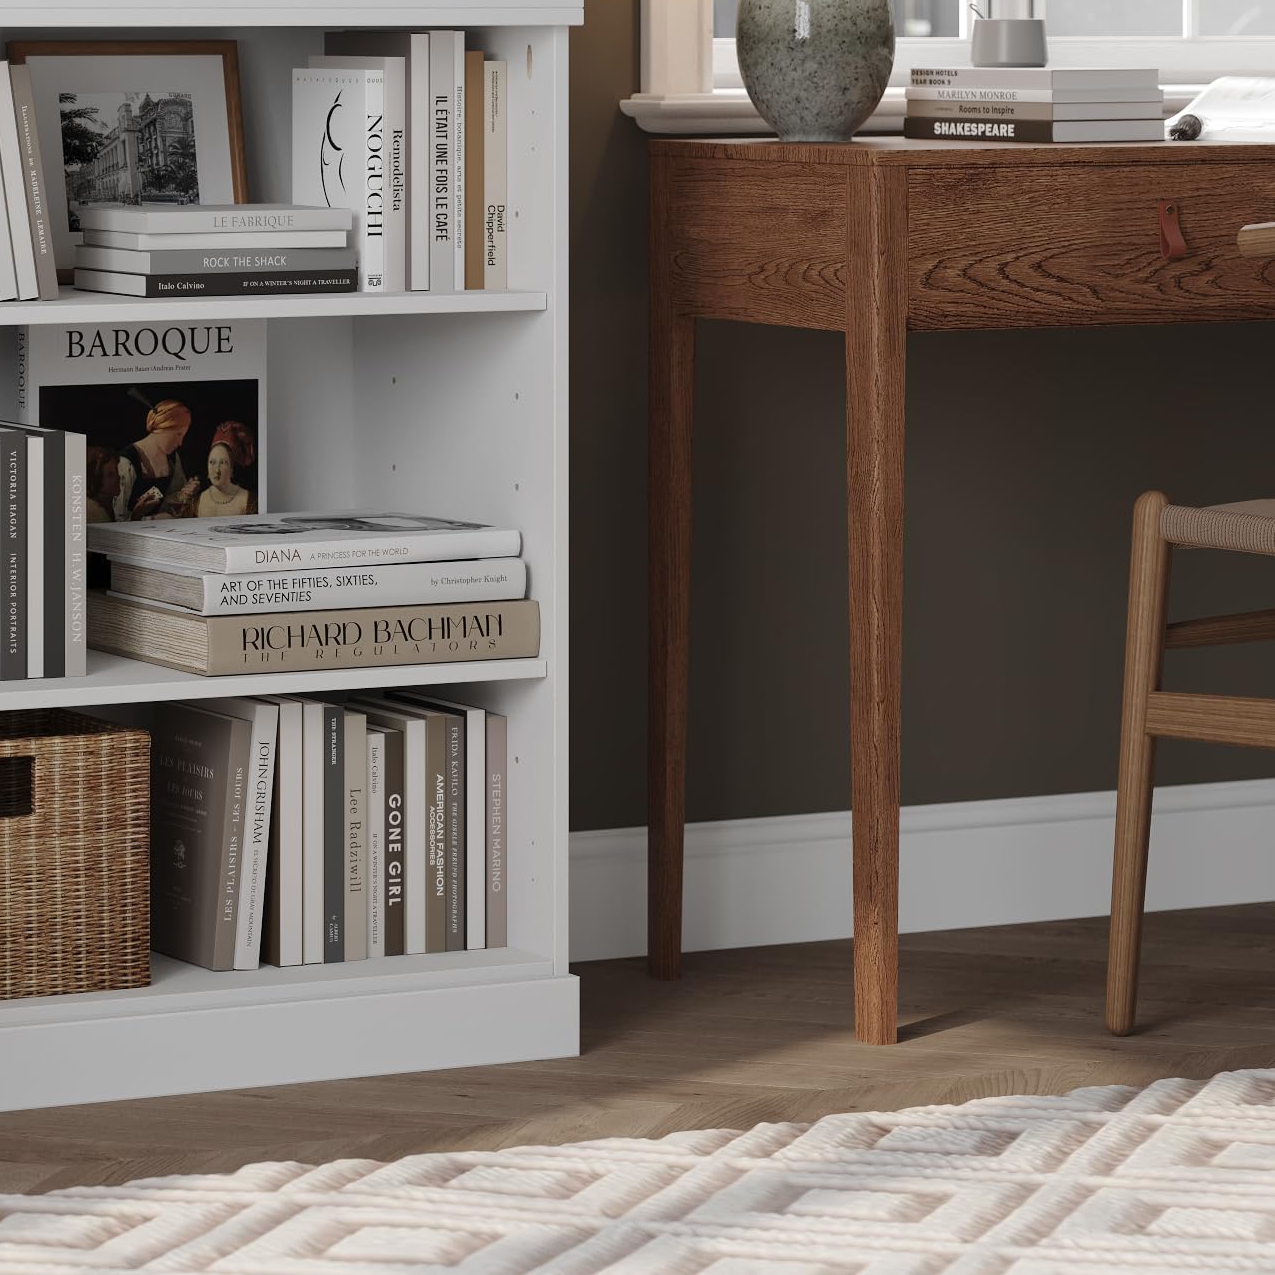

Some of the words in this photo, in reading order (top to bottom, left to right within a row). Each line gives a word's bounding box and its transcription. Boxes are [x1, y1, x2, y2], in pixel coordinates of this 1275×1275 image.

[436, 96, 447, 105] IL
[937, 90, 977, 100] MARILYN
[979, 91, 1017, 101] MONROE
[959, 105, 980, 114] Rooms
[983, 106, 990, 114] to
[992, 106, 1014, 115] Inspire
[436, 109, 450, 139] ÉTAIT
[934, 122, 1015, 137] SHAKESPEARE
[436, 143, 447, 166] UNE
[367, 115, 382, 237] NOGUCHI
[393, 130, 403, 211] Remodelista
[436, 169, 447, 193] FOIS
[436, 197, 447, 210] LE
[497, 205, 505, 232] David
[436, 214, 450, 241] CAFÉ
[486, 205, 496, 266] Chipperfield
[203, 257, 229, 267] ROCK
[233, 257, 251, 267] THE
[255, 256, 287, 266] SHACK
[65, 326, 234, 360] BAROQUE
[10, 451, 18, 500] VICTORIA
[10, 504, 18, 539] HAGAN
[255, 549, 302, 564] DIANA
[220, 595, 248, 605] AND
[252, 591, 312, 604] SEVENTIES
[221, 581, 242, 593] ART
[247, 580, 263, 591] OF
[267, 579, 288, 590] THE
[292, 577, 332, 589] FIFTIES,
[336, 575, 378, 586] SIXTIES,
[243, 622, 362, 651] RICHARD
[374, 614, 502, 644] BACHMAN
[349, 789, 361, 814] Lee
[436, 774, 444, 839] AMERICAN
[492, 773, 501, 834] STEPHEN
[389, 794, 400, 853] GONE
[349, 821, 361, 893] Radziwill
[437, 843, 445, 896] FASHION
[492, 839, 501, 892] MARINO
[389, 861, 401, 906] GIRL
